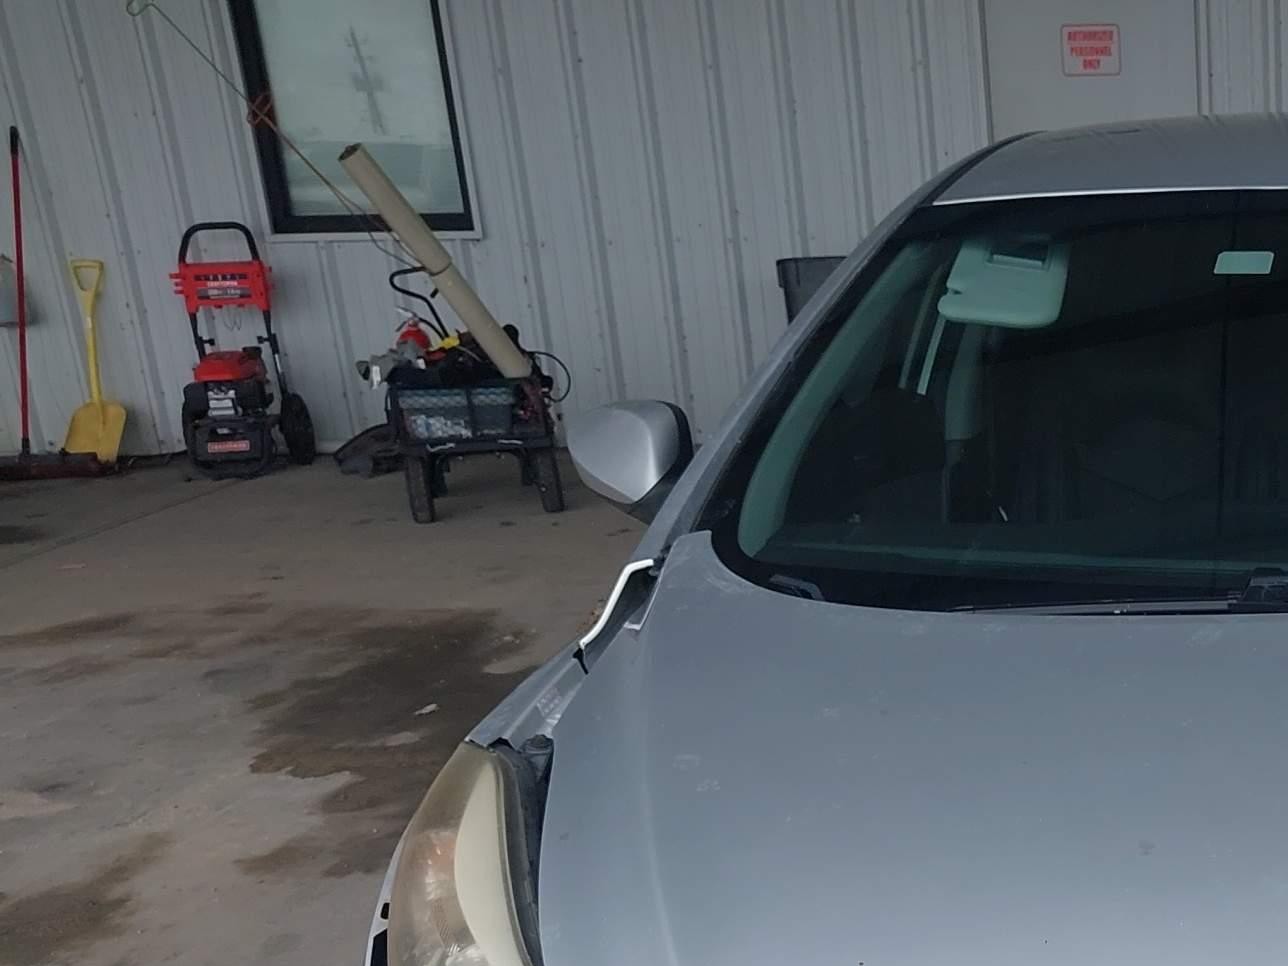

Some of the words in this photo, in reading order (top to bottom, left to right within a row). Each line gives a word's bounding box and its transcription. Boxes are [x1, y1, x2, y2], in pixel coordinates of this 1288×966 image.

[1067, 31, 1114, 41] AUTHORIZED
[1070, 46, 1113, 57] PERSONNEL
[1082, 58, 1101, 70] ONLY
